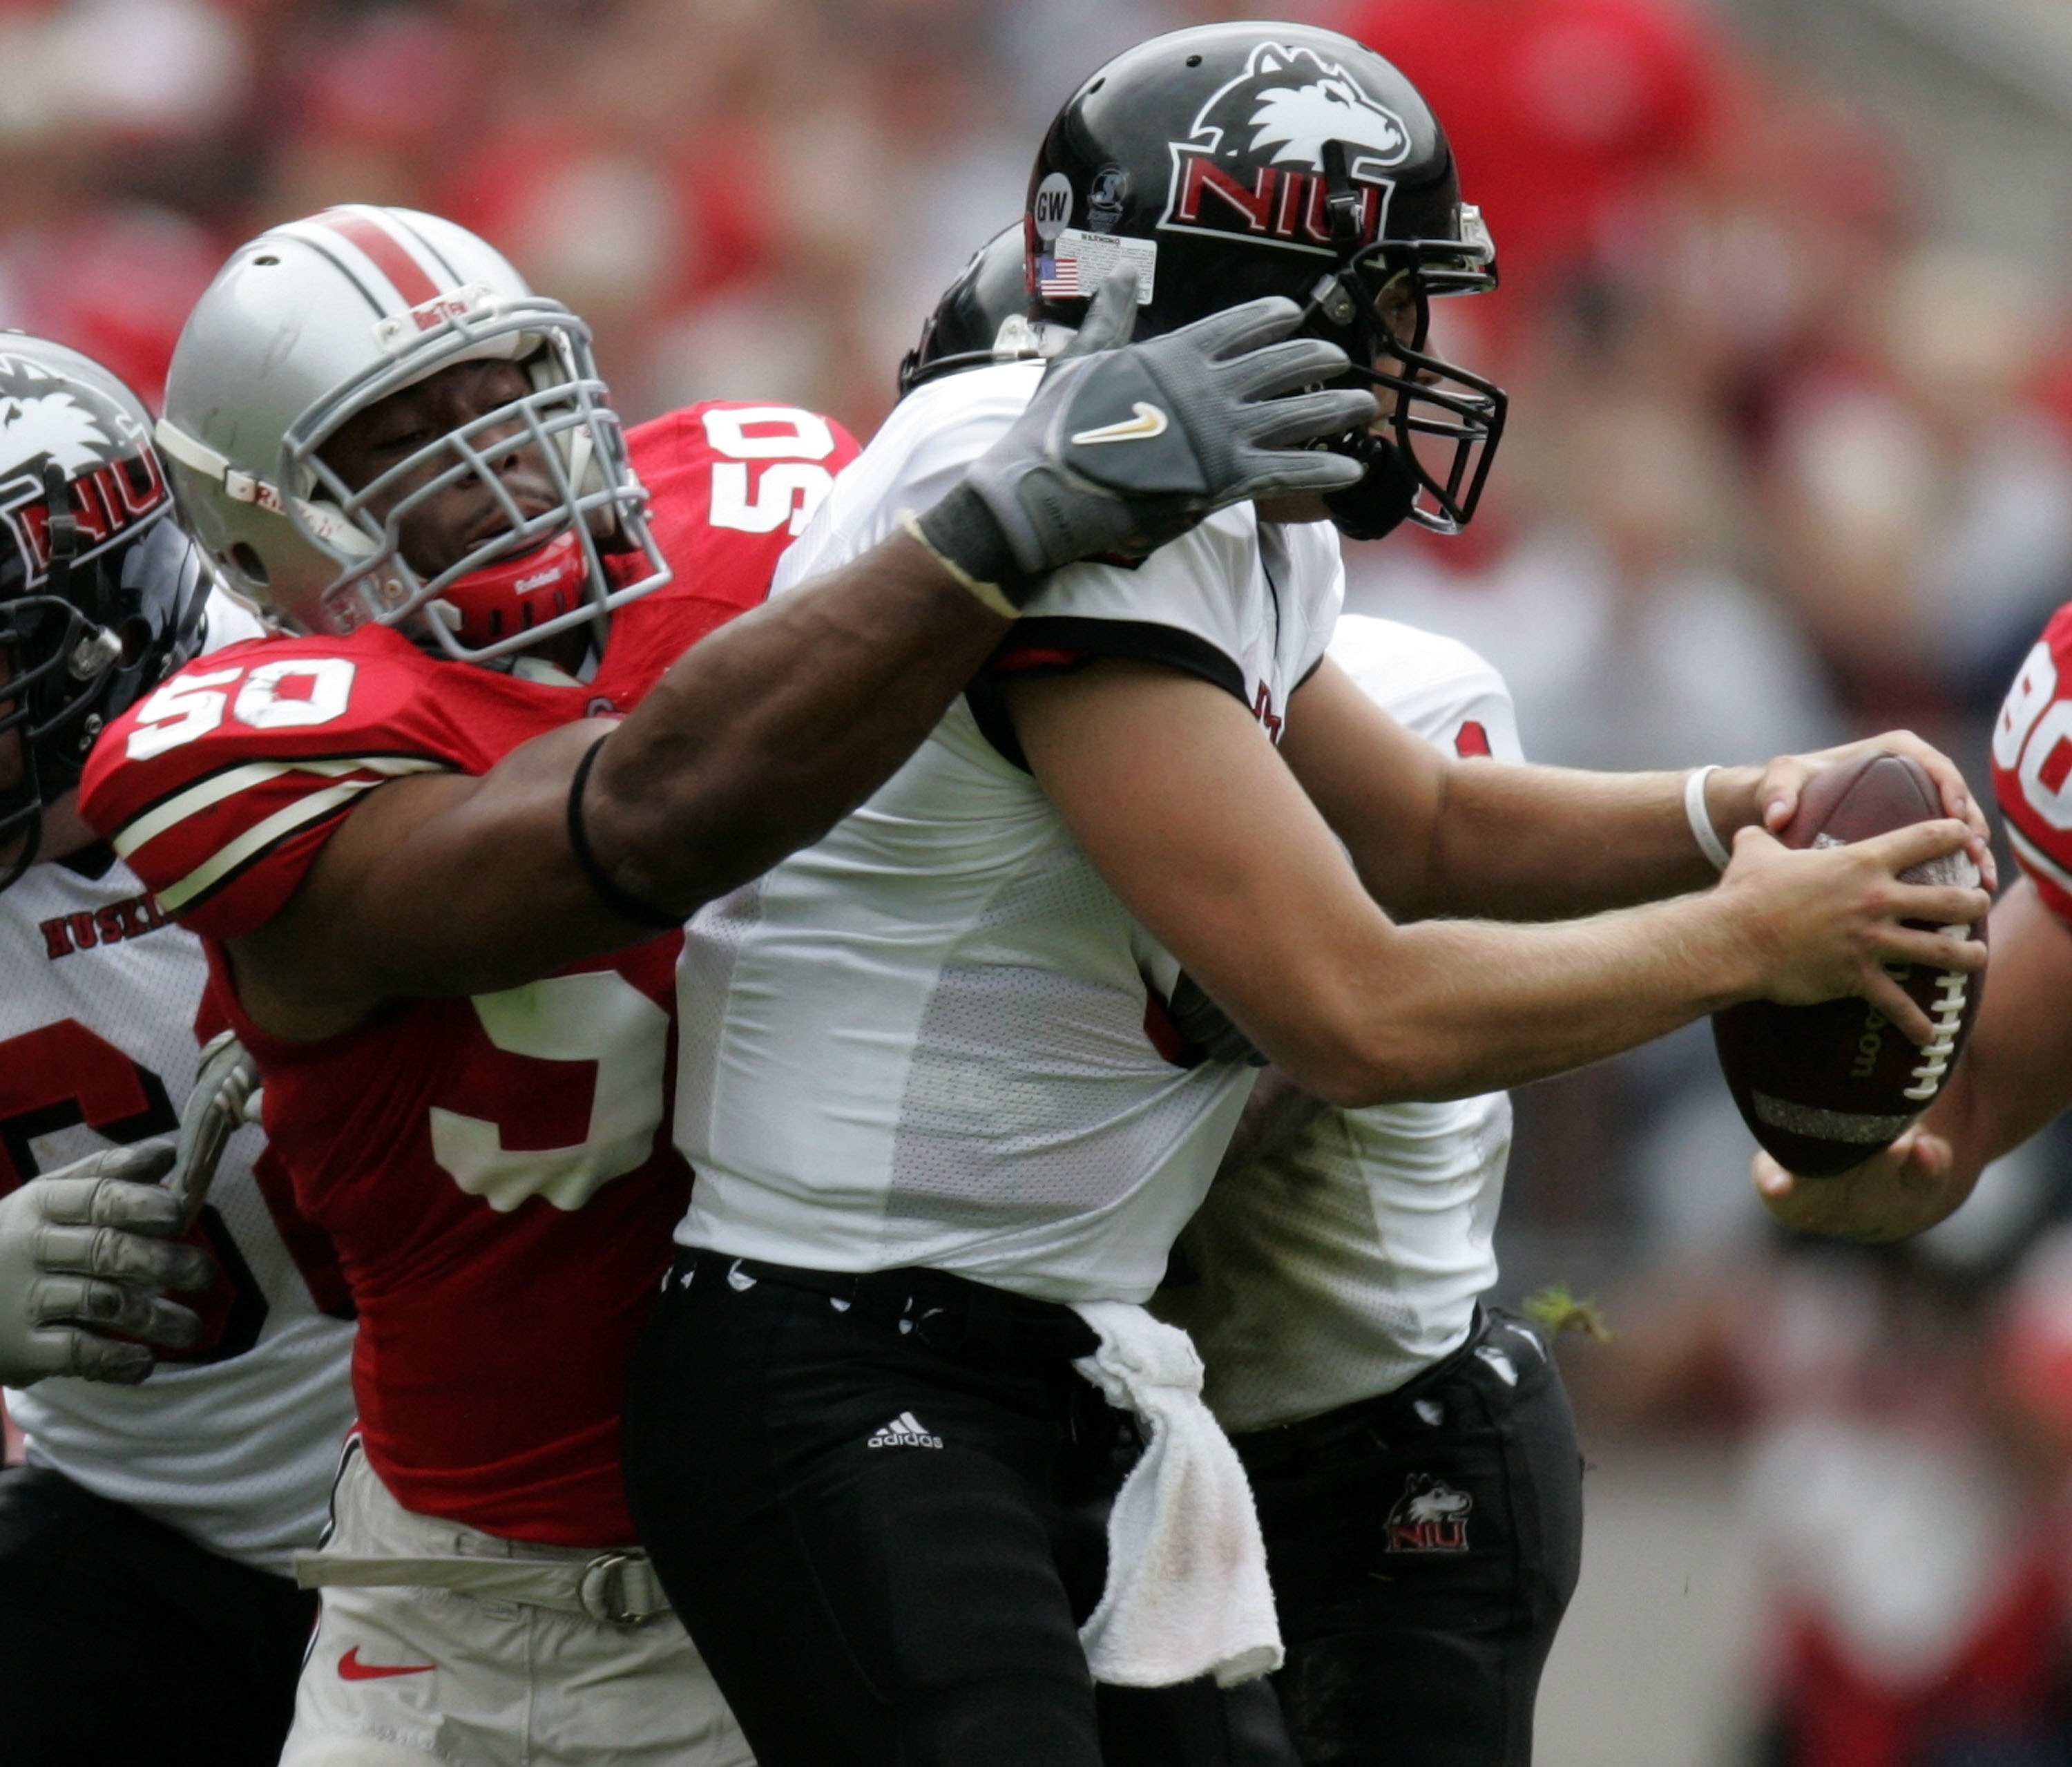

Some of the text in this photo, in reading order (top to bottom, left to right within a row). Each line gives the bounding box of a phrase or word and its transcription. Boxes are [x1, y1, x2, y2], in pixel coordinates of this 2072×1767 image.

[1037, 191, 1068, 222] GW
[1177, 155, 1380, 247] NIU
[19, 441, 166, 571] NIU
[701, 406, 836, 537] 50
[126, 658, 356, 761] 50
[39, 893, 175, 959] HUSKI
[867, 1433, 943, 1449] adidas
[1390, 1520, 1464, 1549] NIU
